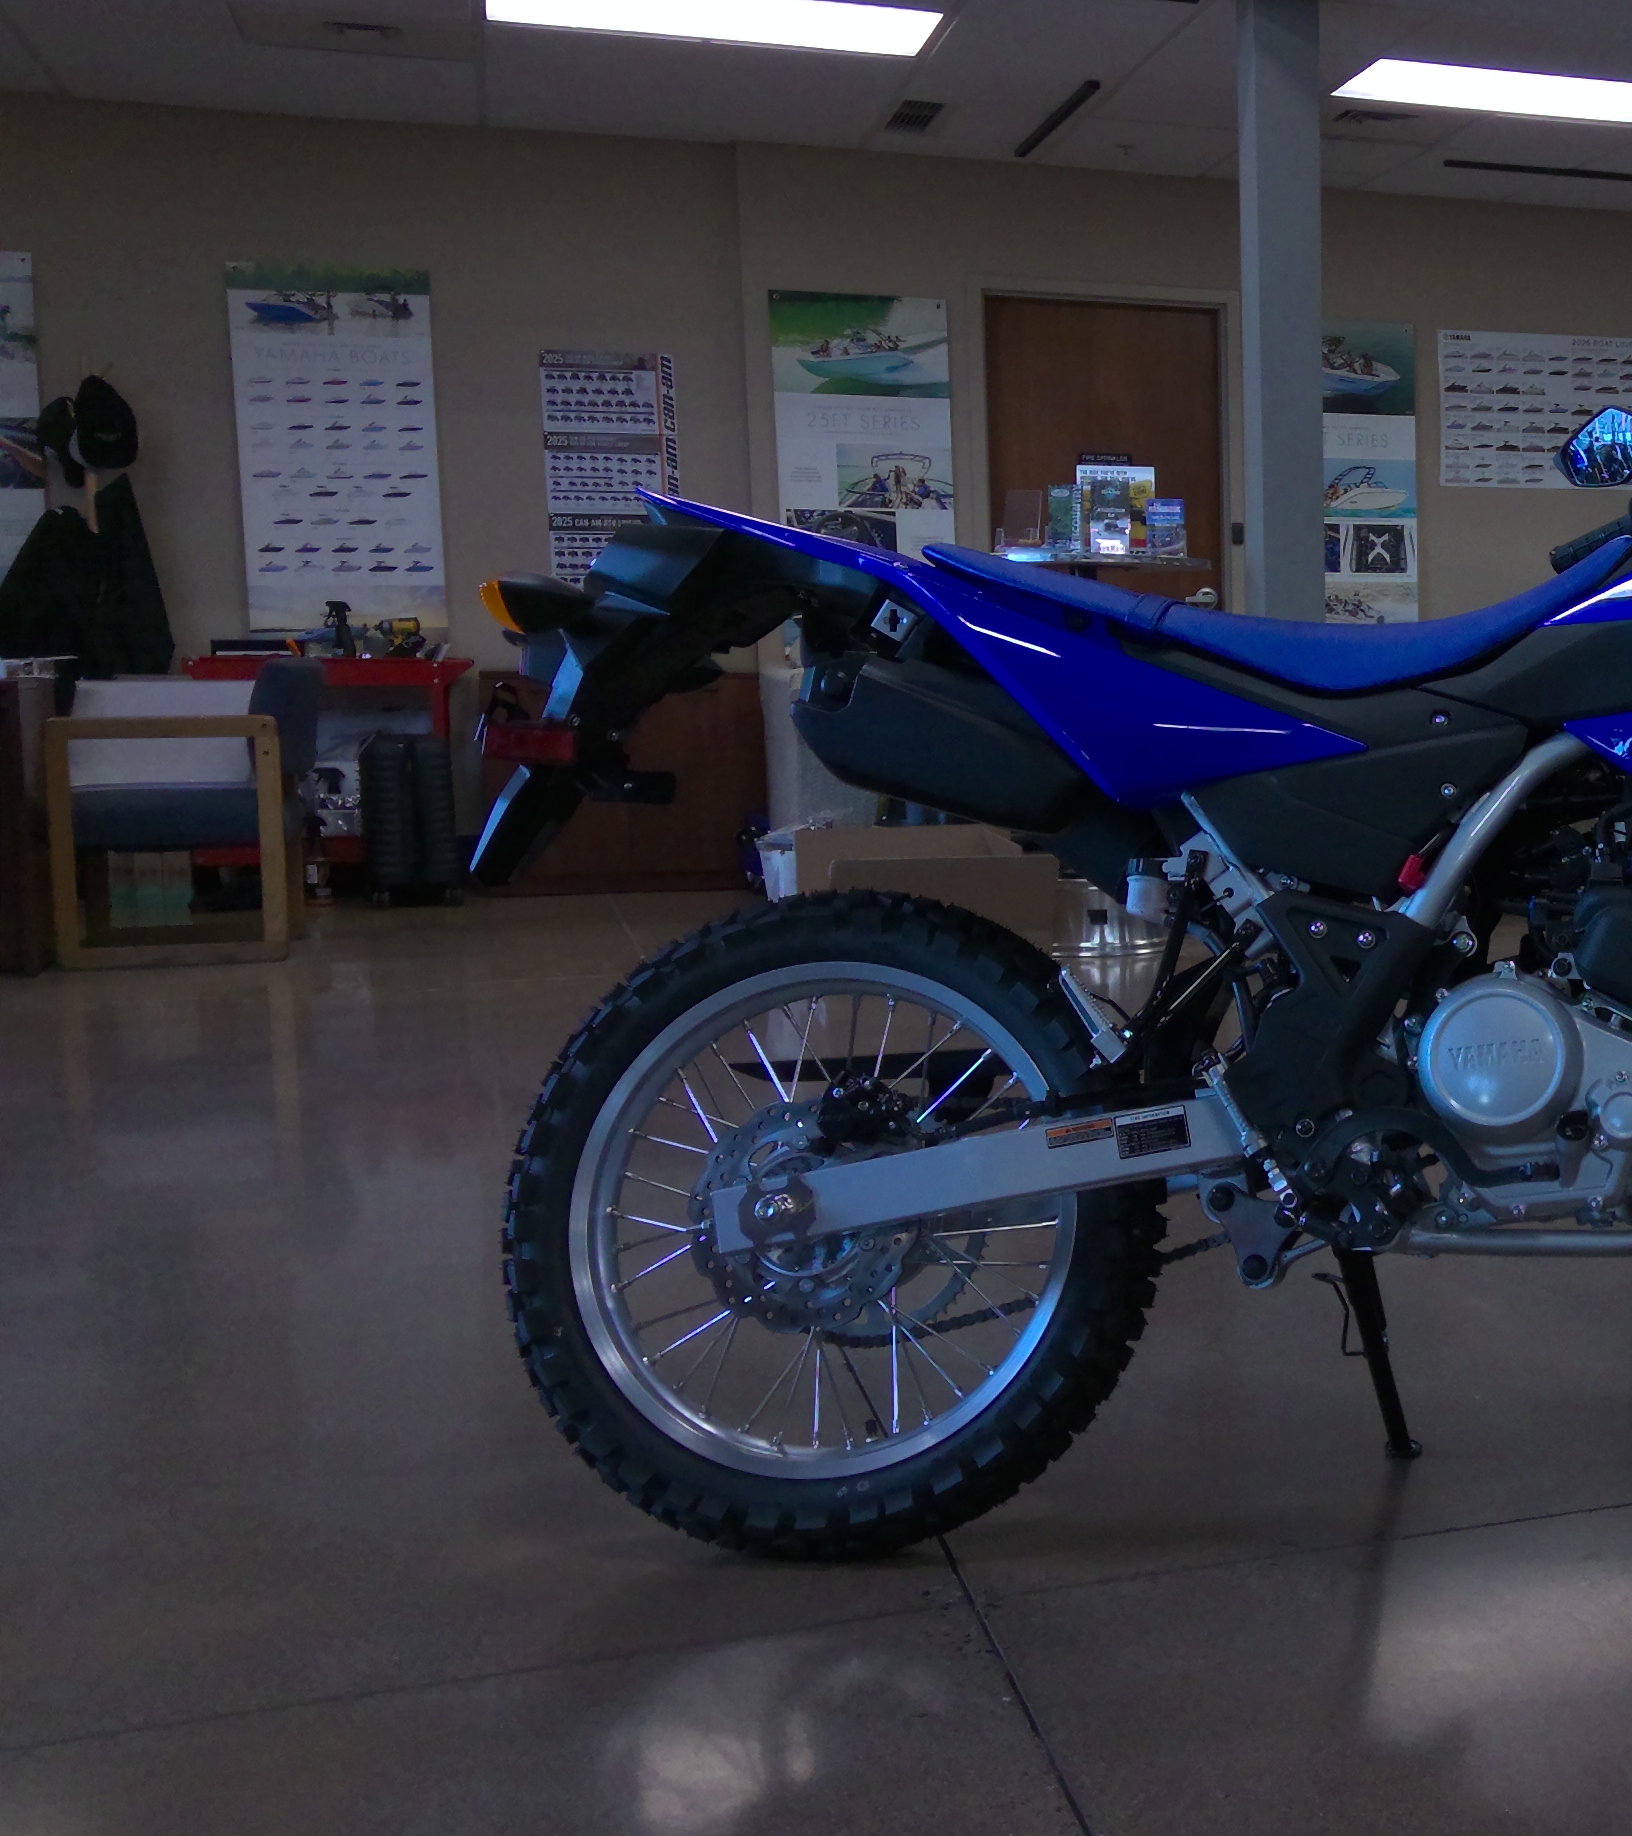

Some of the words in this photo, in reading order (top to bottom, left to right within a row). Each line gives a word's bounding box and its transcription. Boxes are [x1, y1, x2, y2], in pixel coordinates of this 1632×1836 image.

[1593, 339, 1612, 347] BOAT
[253, 347, 341, 363] YAMAHA
[349, 349, 411, 365] BOATS
[542, 354, 564, 364] 2025
[807, 412, 850, 428] 25FT
[860, 414, 921, 431] SERIES
[546, 435, 568, 446] 2025
[1337, 432, 1389, 448] SERIES
[552, 516, 573, 527] 2025
[1447, 1038, 1543, 1070] YAMAHA
